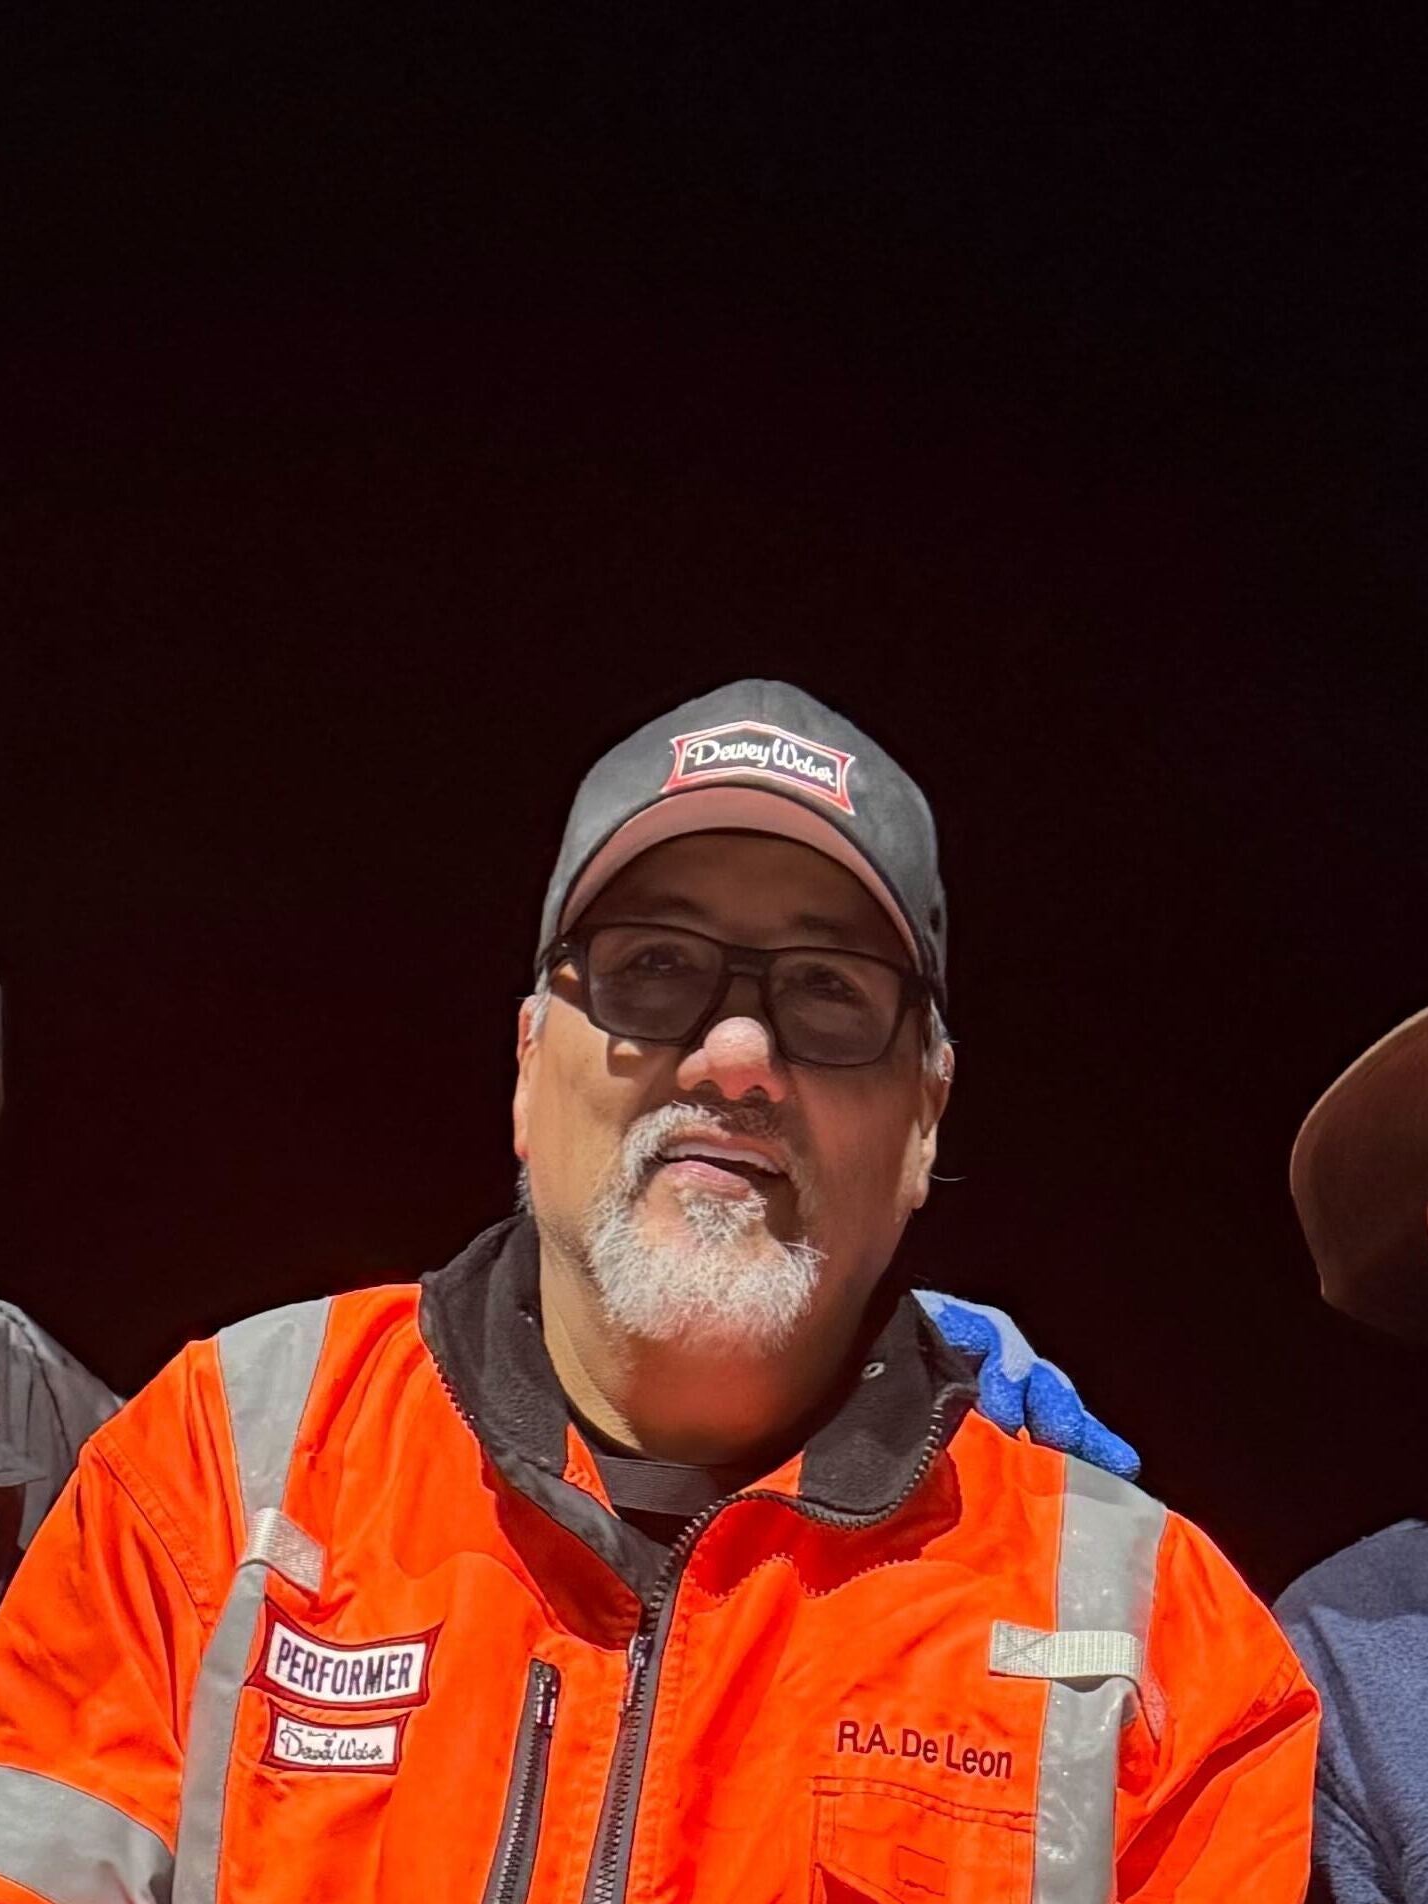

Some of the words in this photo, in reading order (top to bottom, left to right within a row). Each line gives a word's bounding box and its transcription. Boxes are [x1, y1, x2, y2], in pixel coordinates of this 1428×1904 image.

[686, 739, 770, 768] Dewey
[274, 1635, 414, 1696] PERFORMER
[837, 1720, 896, 1755] R.A.
[901, 1728, 939, 1764] De
[945, 1734, 1013, 1780] Leon
